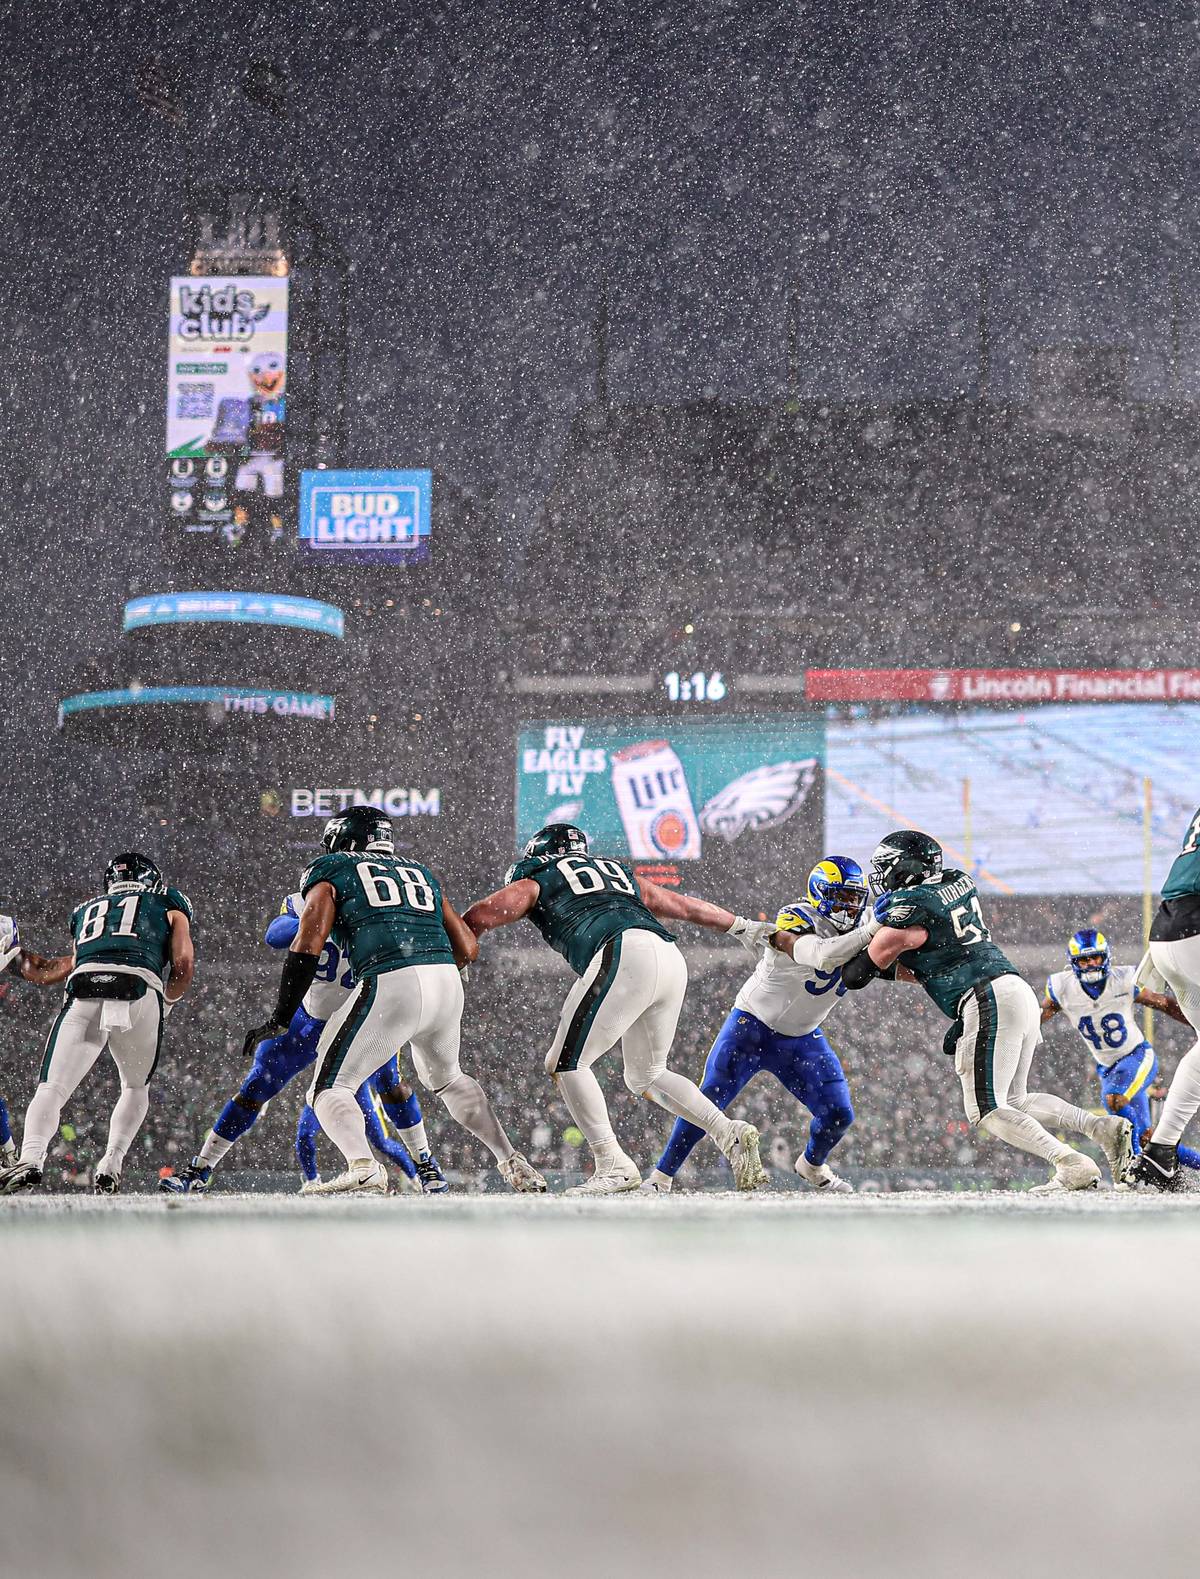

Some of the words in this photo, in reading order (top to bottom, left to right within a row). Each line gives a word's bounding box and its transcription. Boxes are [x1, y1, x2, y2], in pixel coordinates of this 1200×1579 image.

[180, 284, 254, 315] kids
[179, 312, 254, 341] club
[331, 493, 398, 516] BUD
[318, 517, 412, 542] LIGHT
[665, 671, 728, 701] 1:16
[962, 675, 1050, 698] Lincoln
[1056, 673, 1165, 698] Financial
[224, 694, 268, 714] THIS
[545, 726, 585, 750] FLY
[524, 749, 606, 773] EAGLES
[546, 773, 586, 796] FLY
[291, 788, 440, 817] BETMGM
[356, 861, 435, 912] 68
[556, 856, 636, 895] 69
[77, 895, 140, 945] 81
[1078, 1012, 1128, 1050] 48
